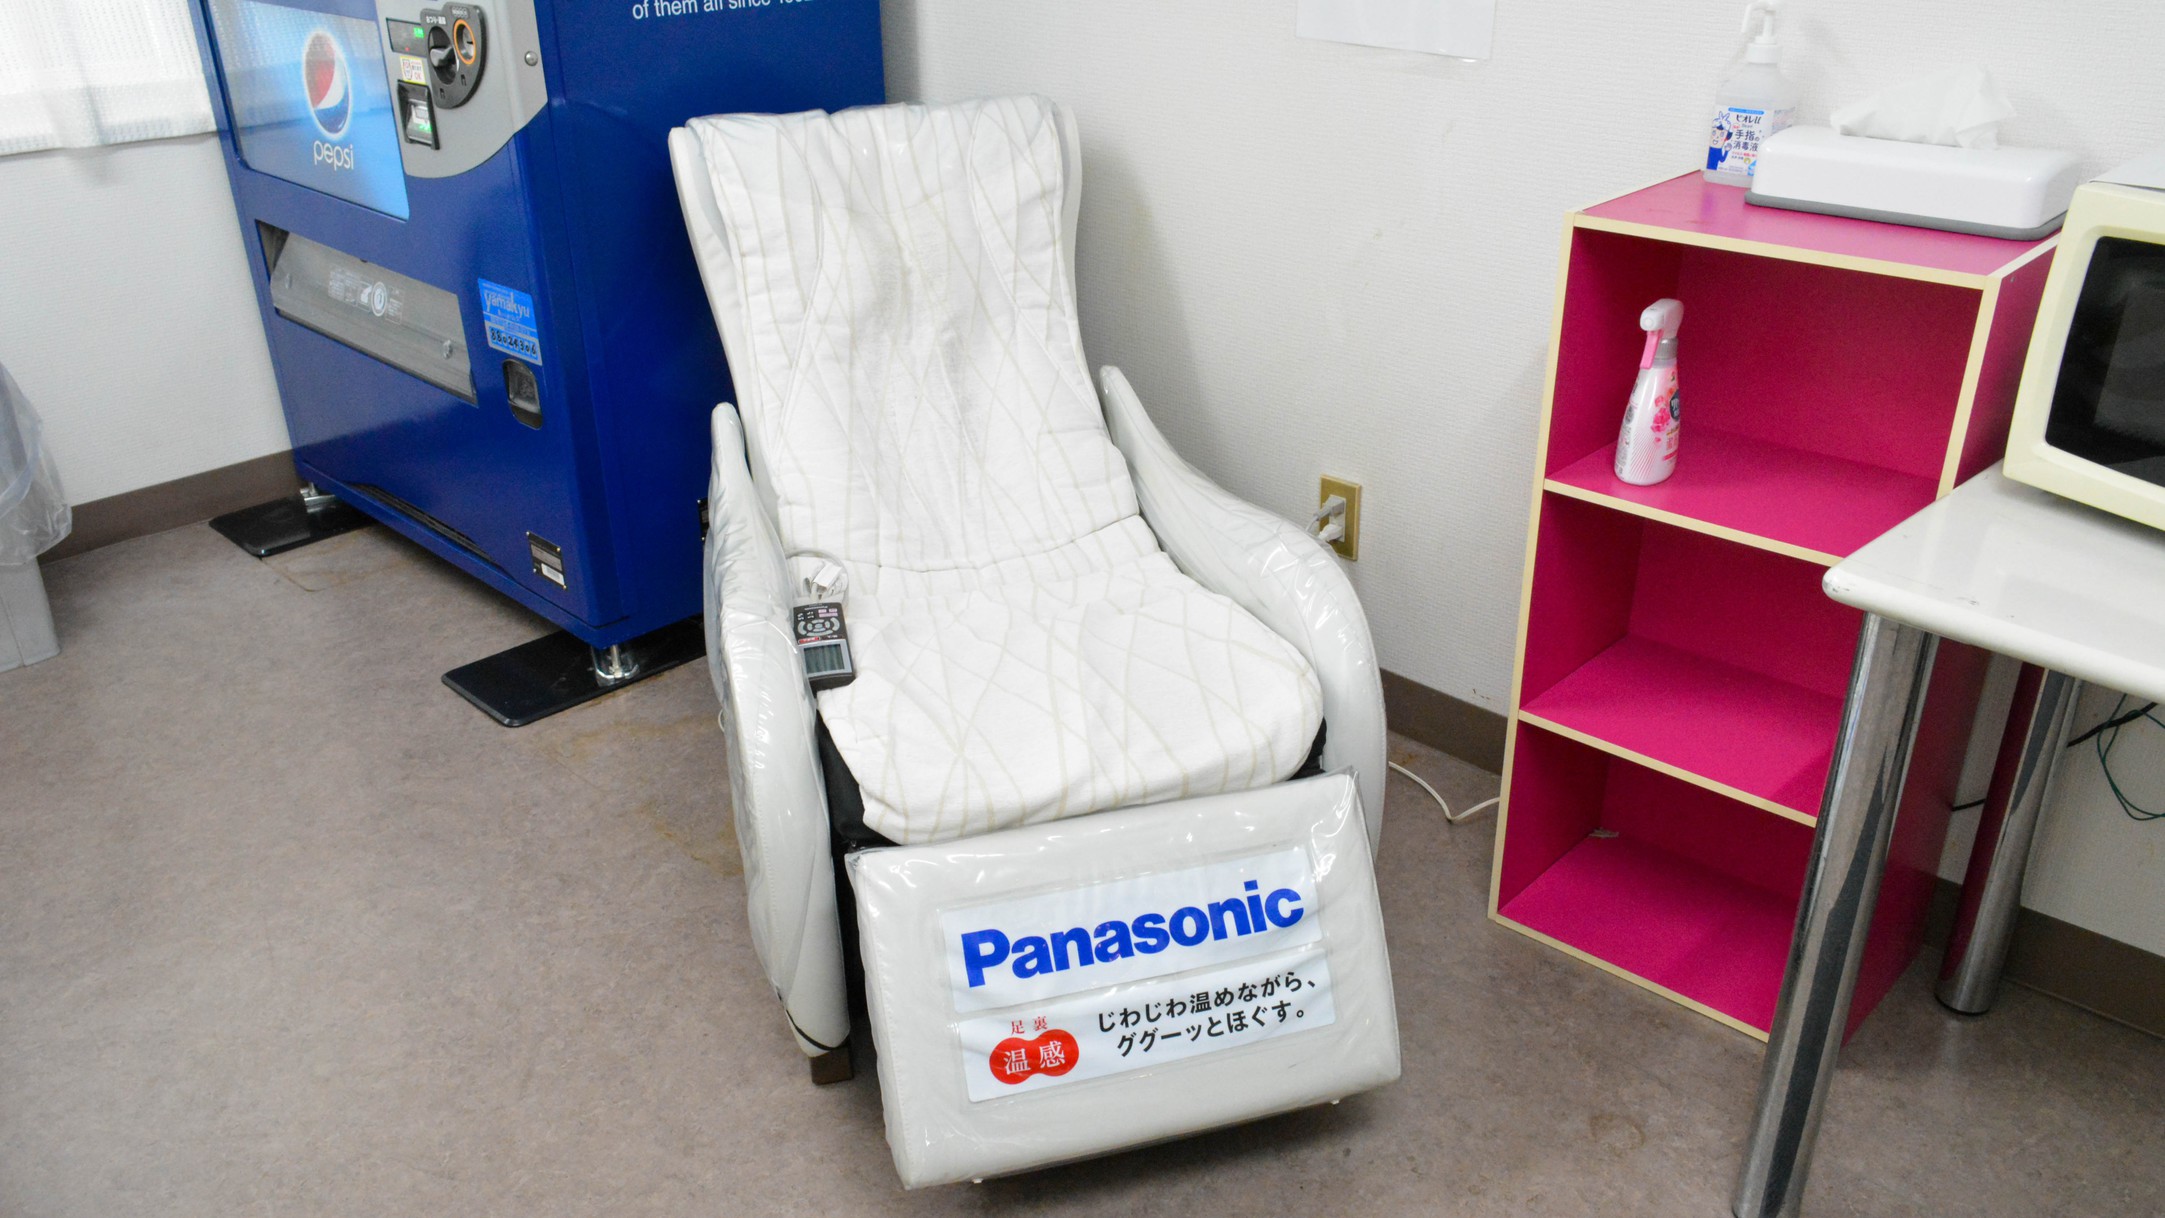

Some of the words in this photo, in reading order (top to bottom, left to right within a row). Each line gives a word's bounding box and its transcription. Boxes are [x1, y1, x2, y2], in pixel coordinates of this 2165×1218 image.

[632, 0, 649, 19] of
[654, 0, 698, 17] them
[1732, 140, 1759, 152] 消毒液
[1735, 129, 1760, 142] 手指の
[313, 140, 354, 171] pepsi
[483, 290, 530, 318] yamakyu
[961, 880, 1304, 988] Panasonic
[1098, 971, 1316, 1033] じわじわ温めながら、
[1010, 1016, 1048, 1036] 足裏
[1117, 1000, 1305, 1057] ググーッとほぐす。
[1003, 1040, 1066, 1075] 温感
